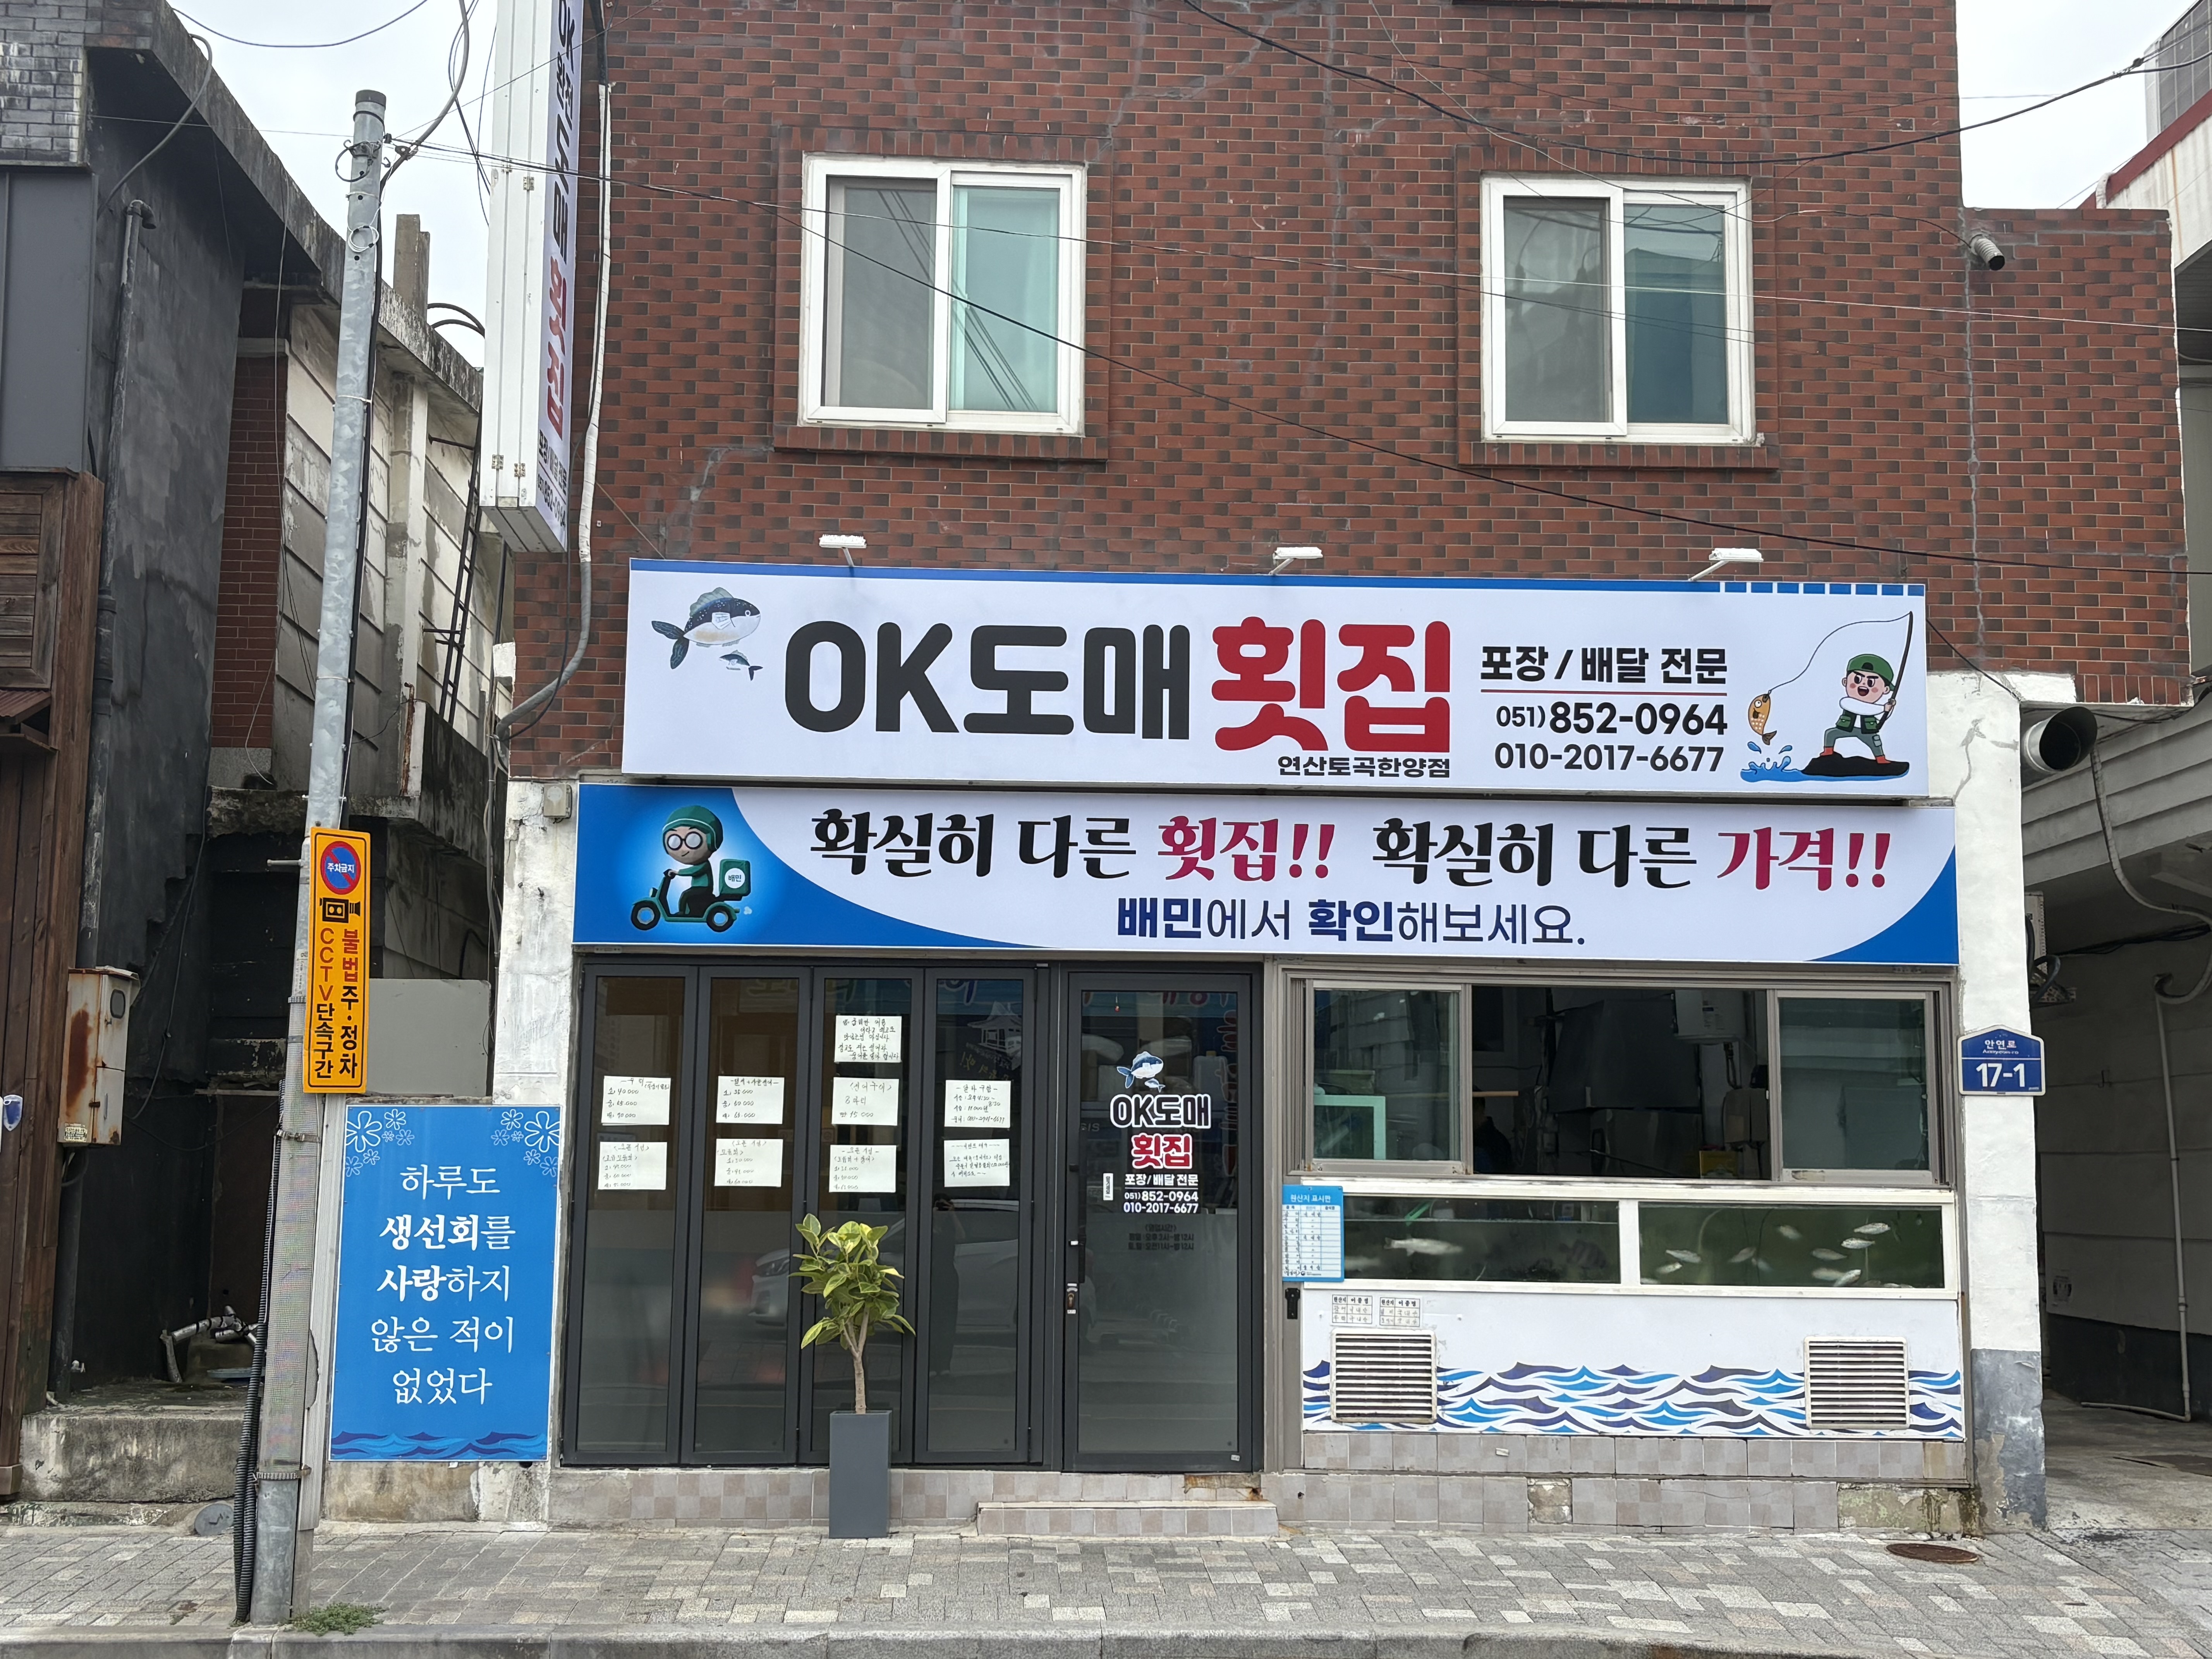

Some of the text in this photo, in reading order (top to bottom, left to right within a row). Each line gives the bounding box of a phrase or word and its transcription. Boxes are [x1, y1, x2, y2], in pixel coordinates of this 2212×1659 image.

[1661, 649, 1727, 684] 전문
[785, 617, 1450, 752] OK도매 횟집
[1278, 756, 1449, 778] 연산토곡한양점
[1495, 743, 1723, 771] 010-2017-6677
[811, 808, 1890, 891] 확실히 다른 횟집!! 확실히 다른 가격!!
[327, 863, 354, 873] 주차금지
[1118, 898, 1584, 946] 배민에서 확인해보세요.
[1984, 1040, 2017, 1050] 안연로
[1976, 1063, 2025, 1087] 17-1
[1110, 1094, 1211, 1128] OK도매
[1131, 1132, 1192, 1169] 횟집
[400, 1164, 500, 1200] 하루도
[1177, 1174, 1199, 1185] 전문
[1124, 1202, 1199, 1213] 010-2017-6677
[1290, 1194, 1309, 1203] 원산지
[380, 1214, 515, 1251] 생선회를
[377, 1265, 510, 1302] 사랑하지
[371, 1317, 514, 1353] 않은 적이
[393, 1368, 493, 1405] 없었다
